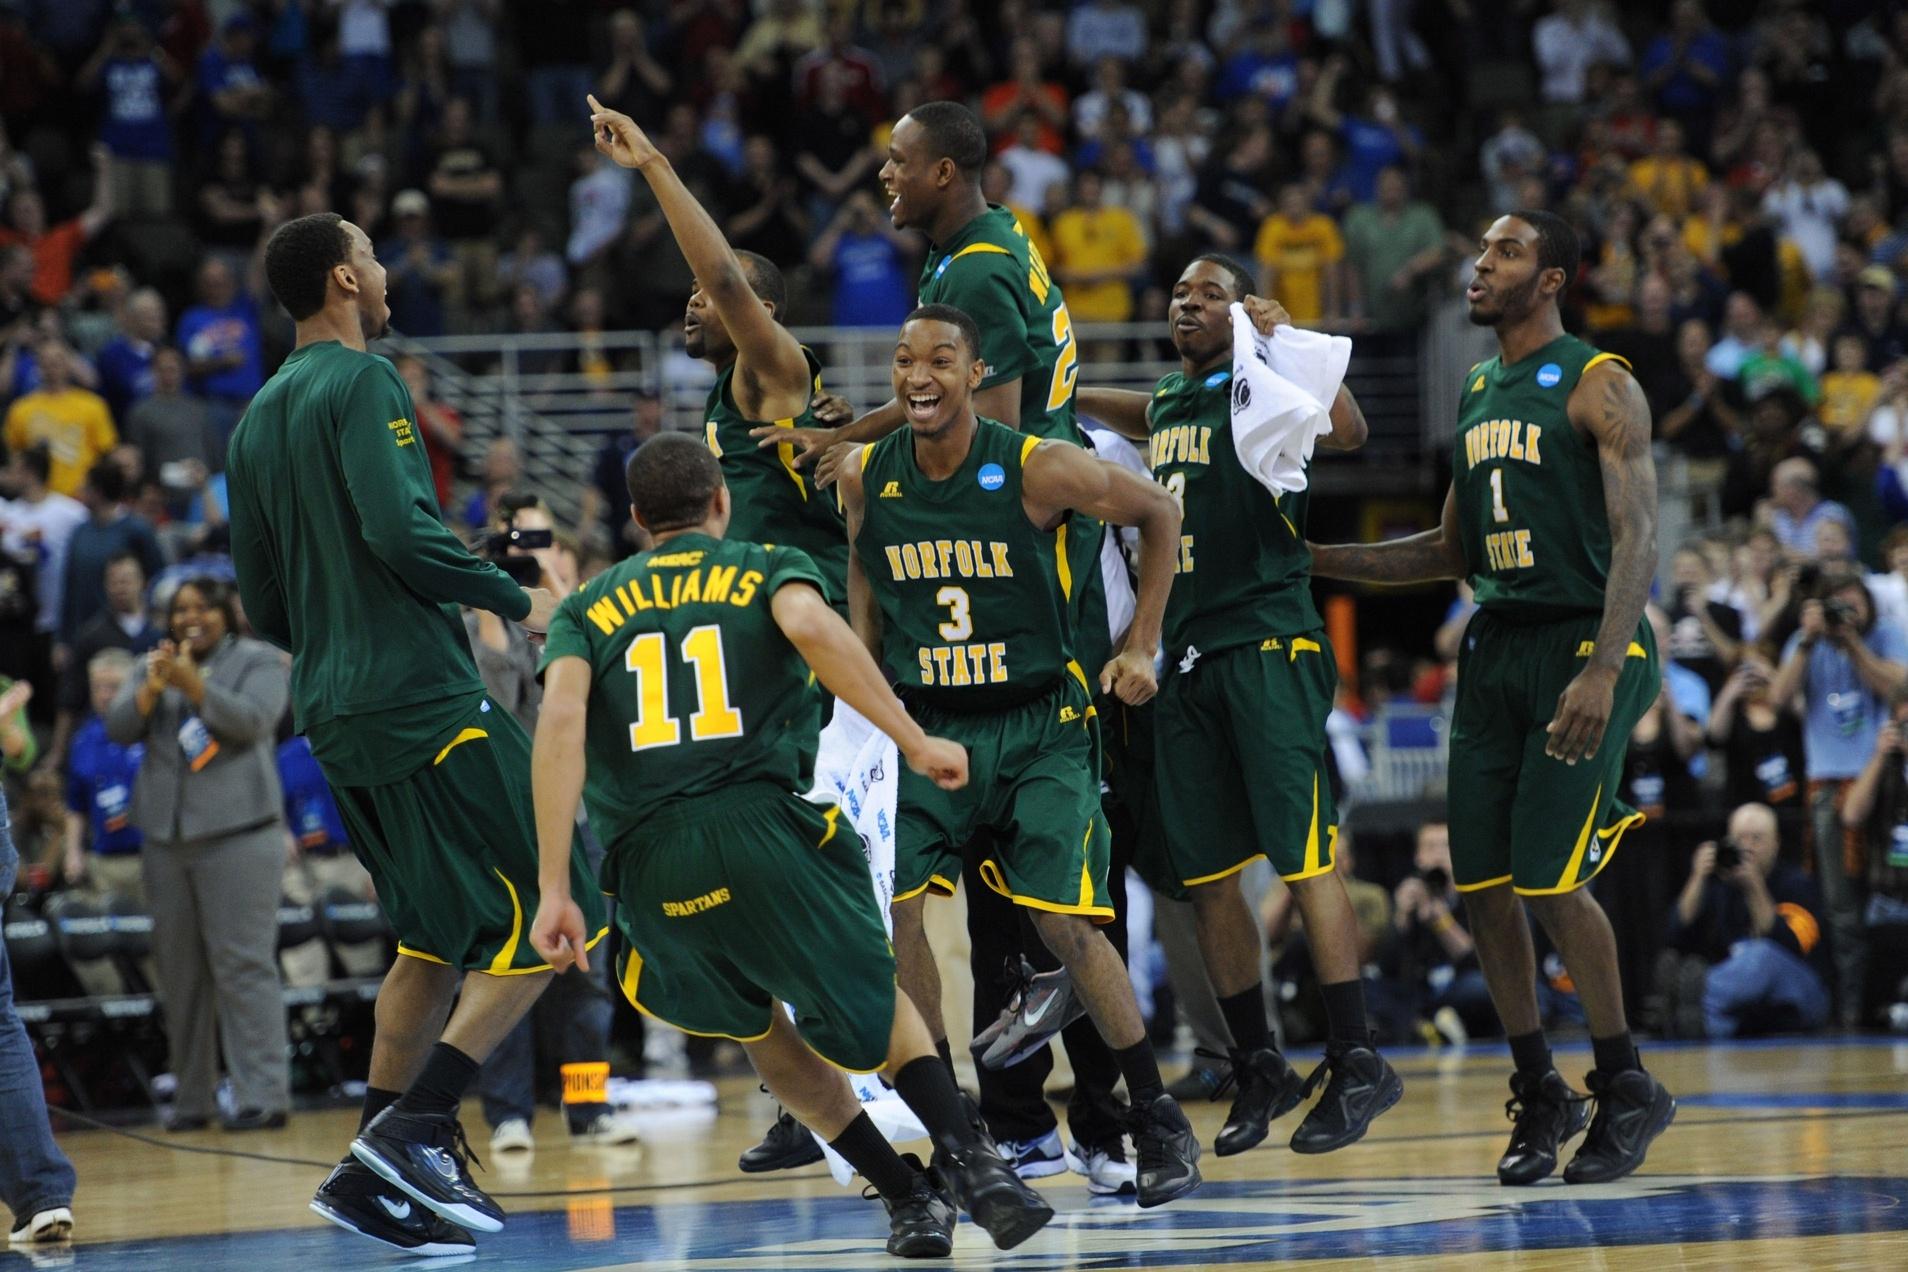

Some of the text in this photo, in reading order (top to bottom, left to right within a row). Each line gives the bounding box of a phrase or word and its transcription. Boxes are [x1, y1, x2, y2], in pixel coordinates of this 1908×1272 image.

[1465, 419, 1541, 470] NORFOLK
[981, 475, 1003, 485] NCAA
[1490, 468, 1509, 523] 1
[885, 540, 1013, 581] NORFOLK
[1486, 529, 1534, 571] STATE
[587, 565, 764, 636] WILLIAMS
[936, 585, 973, 641] 3
[918, 642, 1008, 686] STATE
[625, 624, 743, 752] 11
[662, 887, 731, 917] SPARTANS
